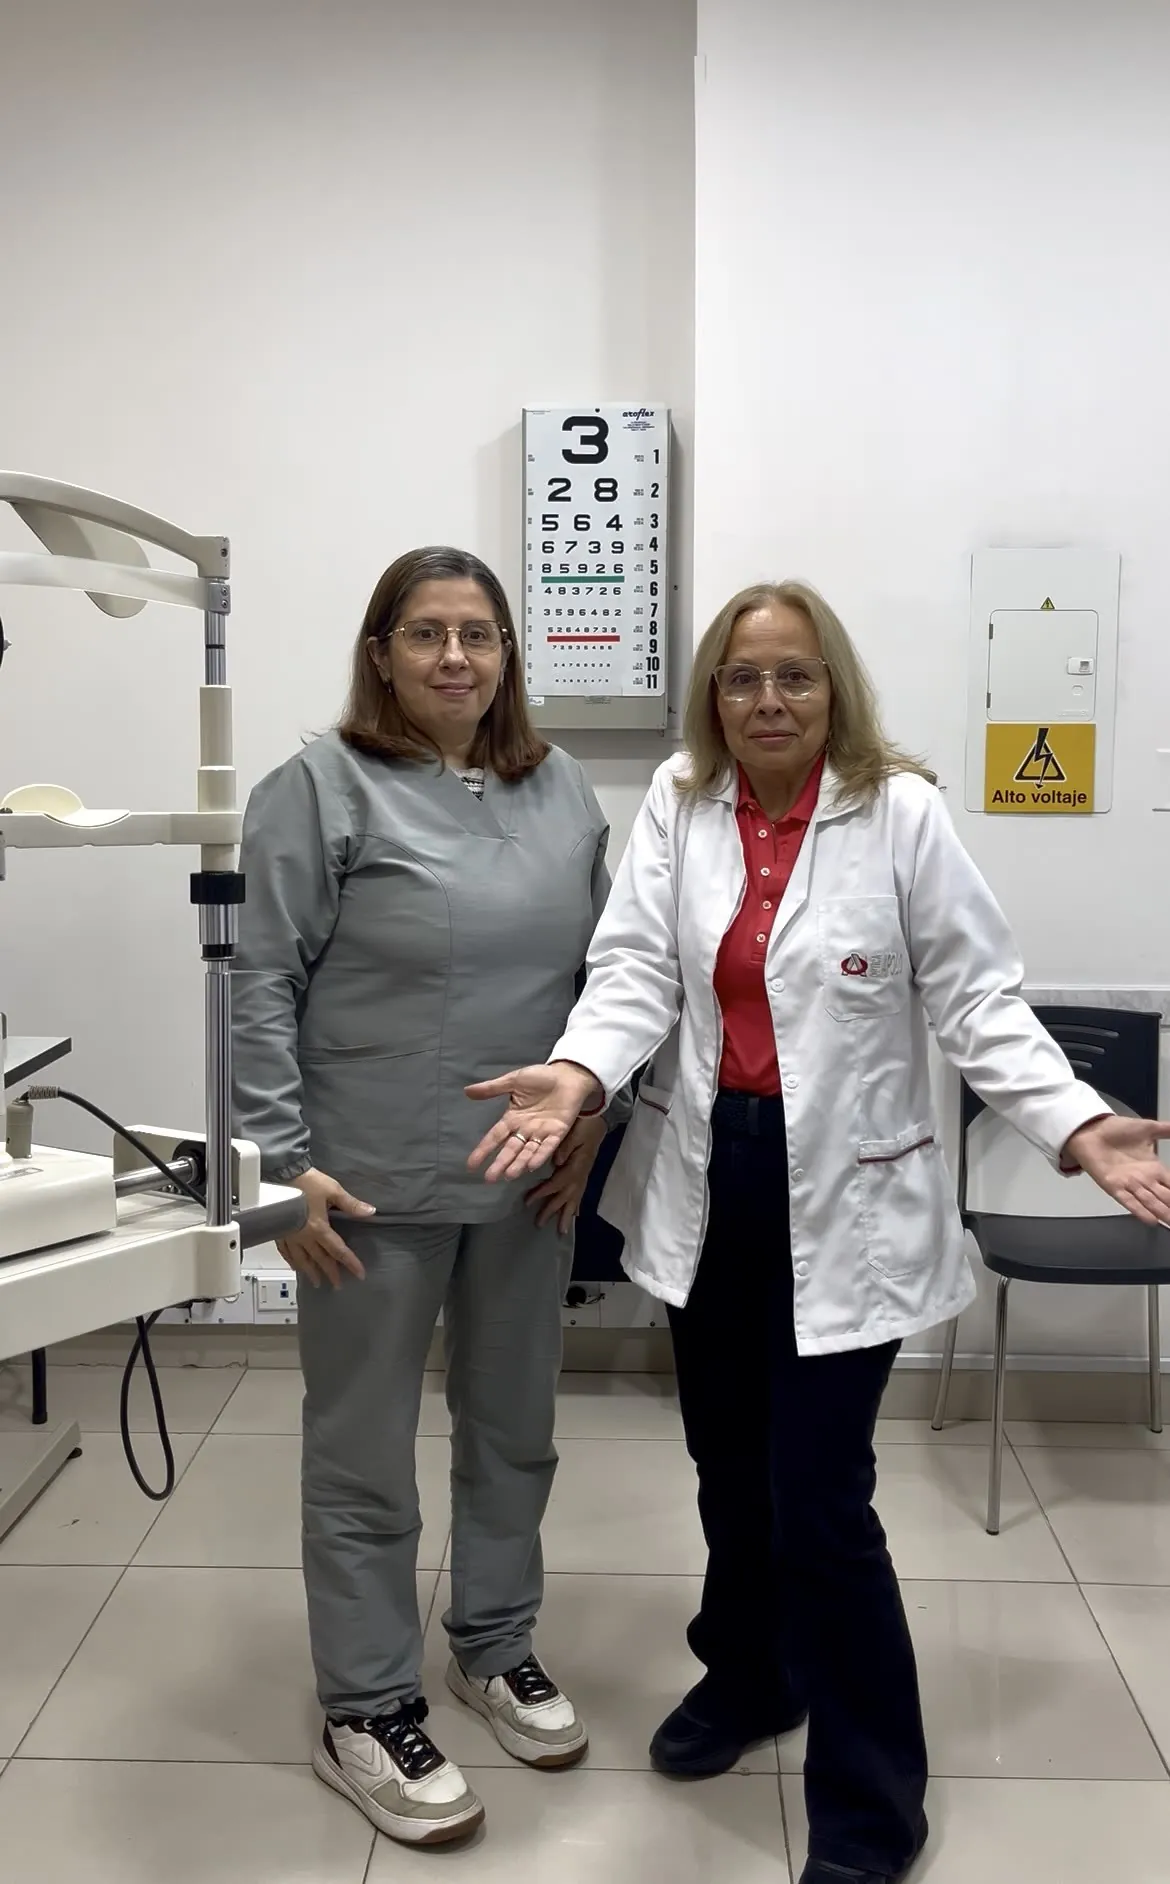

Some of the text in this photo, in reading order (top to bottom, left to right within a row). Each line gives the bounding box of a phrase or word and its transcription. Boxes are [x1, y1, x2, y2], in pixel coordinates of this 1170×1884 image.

[562, 416, 609, 464] 3
[653, 449, 659, 464] 1
[548, 478, 618, 502] 2 8
[651, 483, 659, 498] 2
[542, 514, 559, 531] 5
[574, 514, 591, 531] 6
[606, 514, 623, 531] 4
[650, 514, 658, 529] 3
[649, 537, 658, 552] 4
[650, 560, 658, 575] 5
[650, 582, 658, 596] 6
[651, 603, 658, 617] 7
[650, 621, 658, 636] 8
[650, 639, 658, 654] 9
[646, 656, 660, 671] 10
[646, 674, 657, 689] 11
[992, 790, 1087, 808] Alto voltaje
